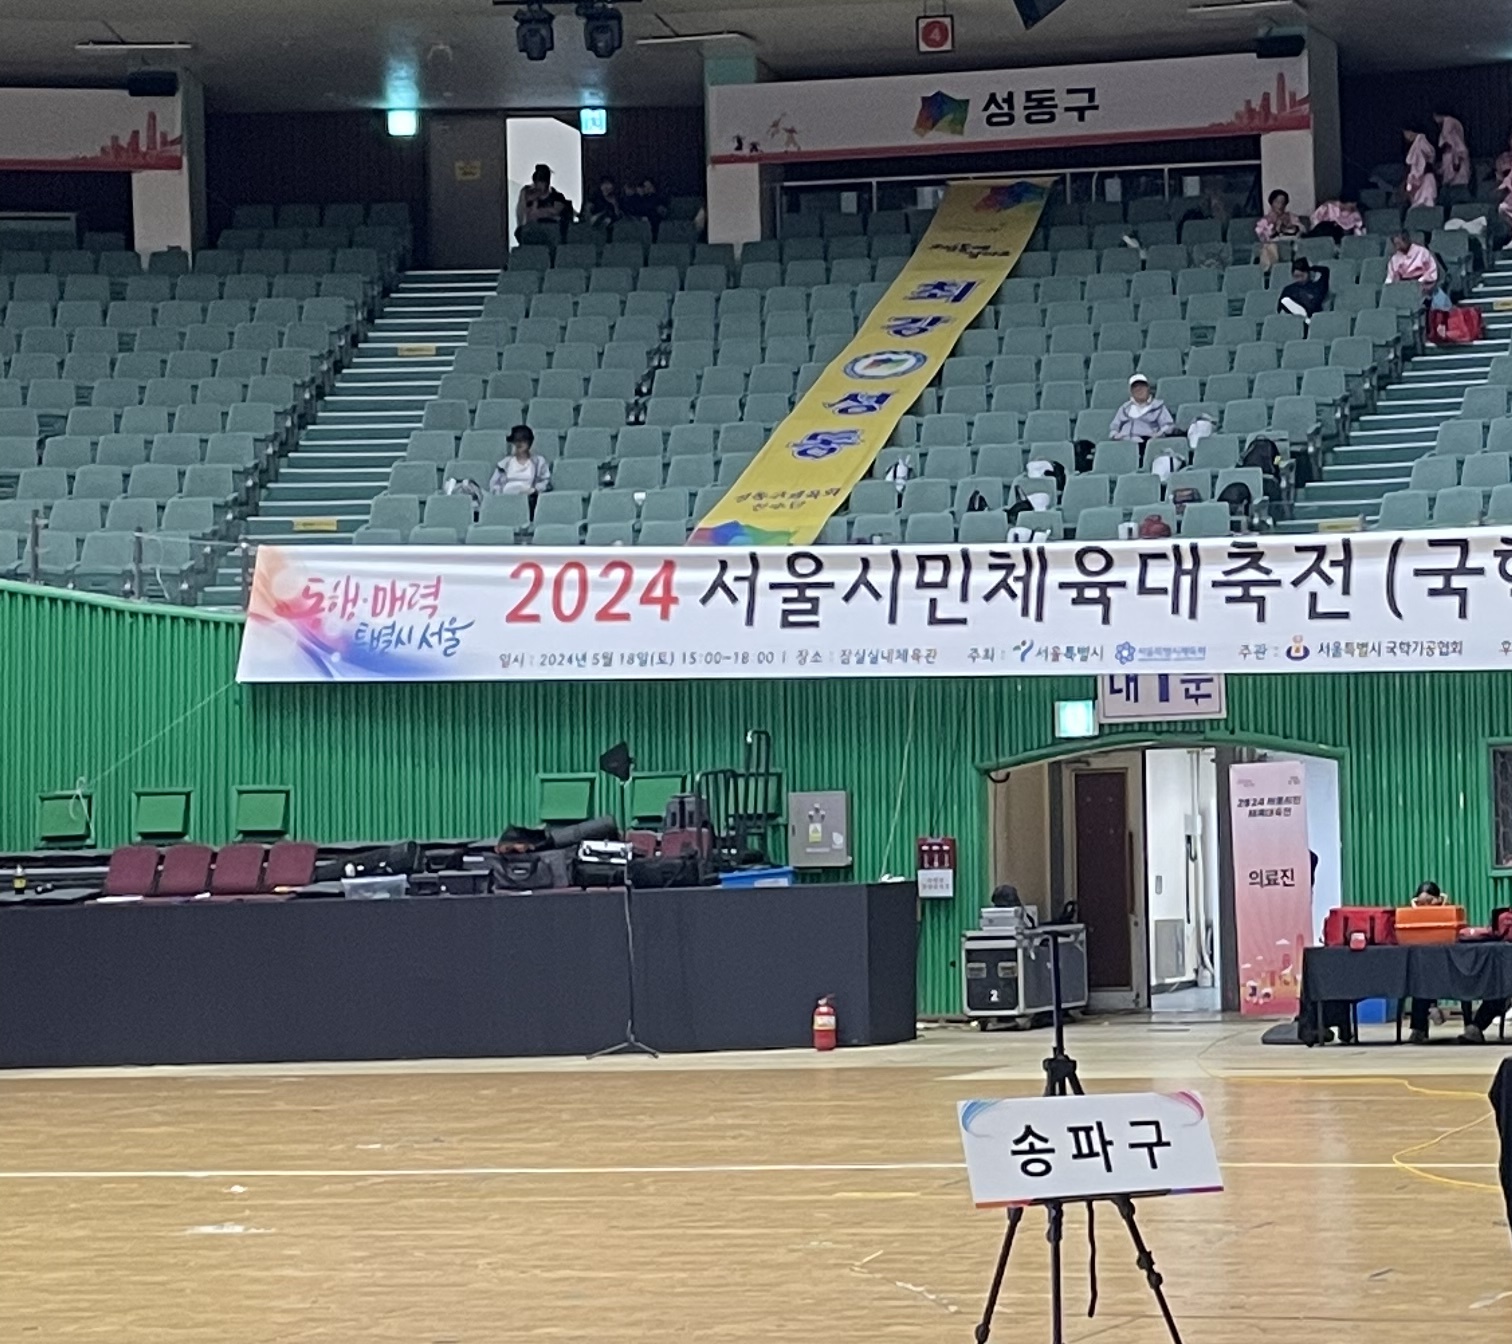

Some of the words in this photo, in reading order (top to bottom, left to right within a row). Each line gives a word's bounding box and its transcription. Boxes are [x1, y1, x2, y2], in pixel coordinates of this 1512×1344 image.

[981, 86, 1100, 127] 성동구
[504, 558, 680, 624] 2024
[354, 619, 415, 655] 특별시
[417, 617, 476, 657] 서울
[500, 651, 525, 668] 일시
[539, 650, 587, 668] 2024년
[591, 651, 614, 668] 5월
[796, 648, 823, 666] 장소
[840, 647, 938, 665] 잠실실내체육관
[967, 645, 995, 664] 주최
[1035, 644, 1104, 663] 서울특별시
[1238, 643, 1268, 661] 주관
[1317, 640, 1382, 658] 서울특별시
[1385, 640, 1463, 658] 국학기공협회
[1248, 867, 1296, 889] 의료진
[990, 989, 999, 1002] 2
[1010, 1119, 1172, 1178] 송파구
